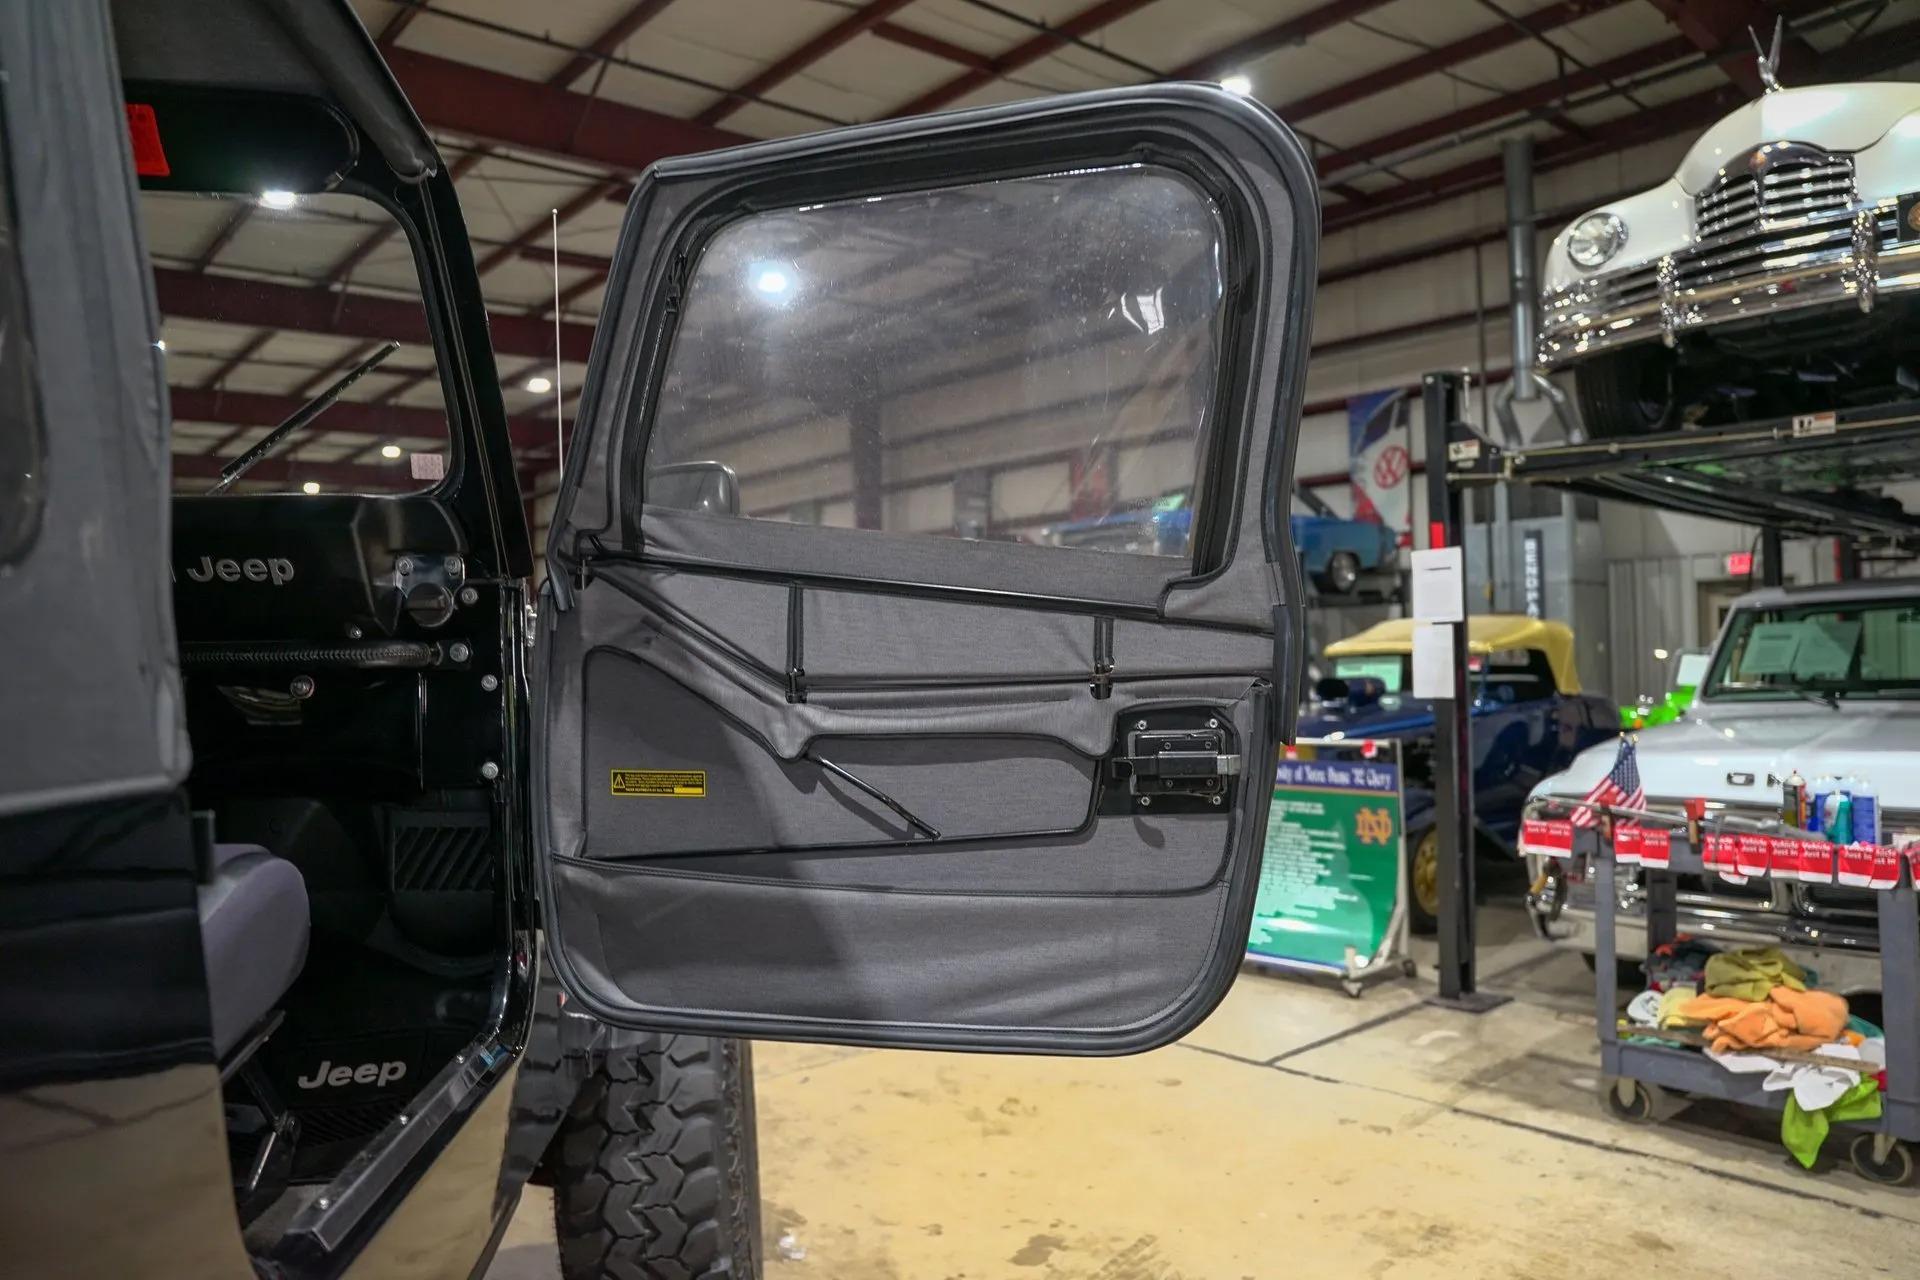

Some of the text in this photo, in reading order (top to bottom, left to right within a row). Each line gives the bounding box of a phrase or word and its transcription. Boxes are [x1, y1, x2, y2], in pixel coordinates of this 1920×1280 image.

[186, 556, 294, 585] Jeep
[1525, 538, 1539, 617] BENDPA
[298, 1060, 407, 1089] Jeep
